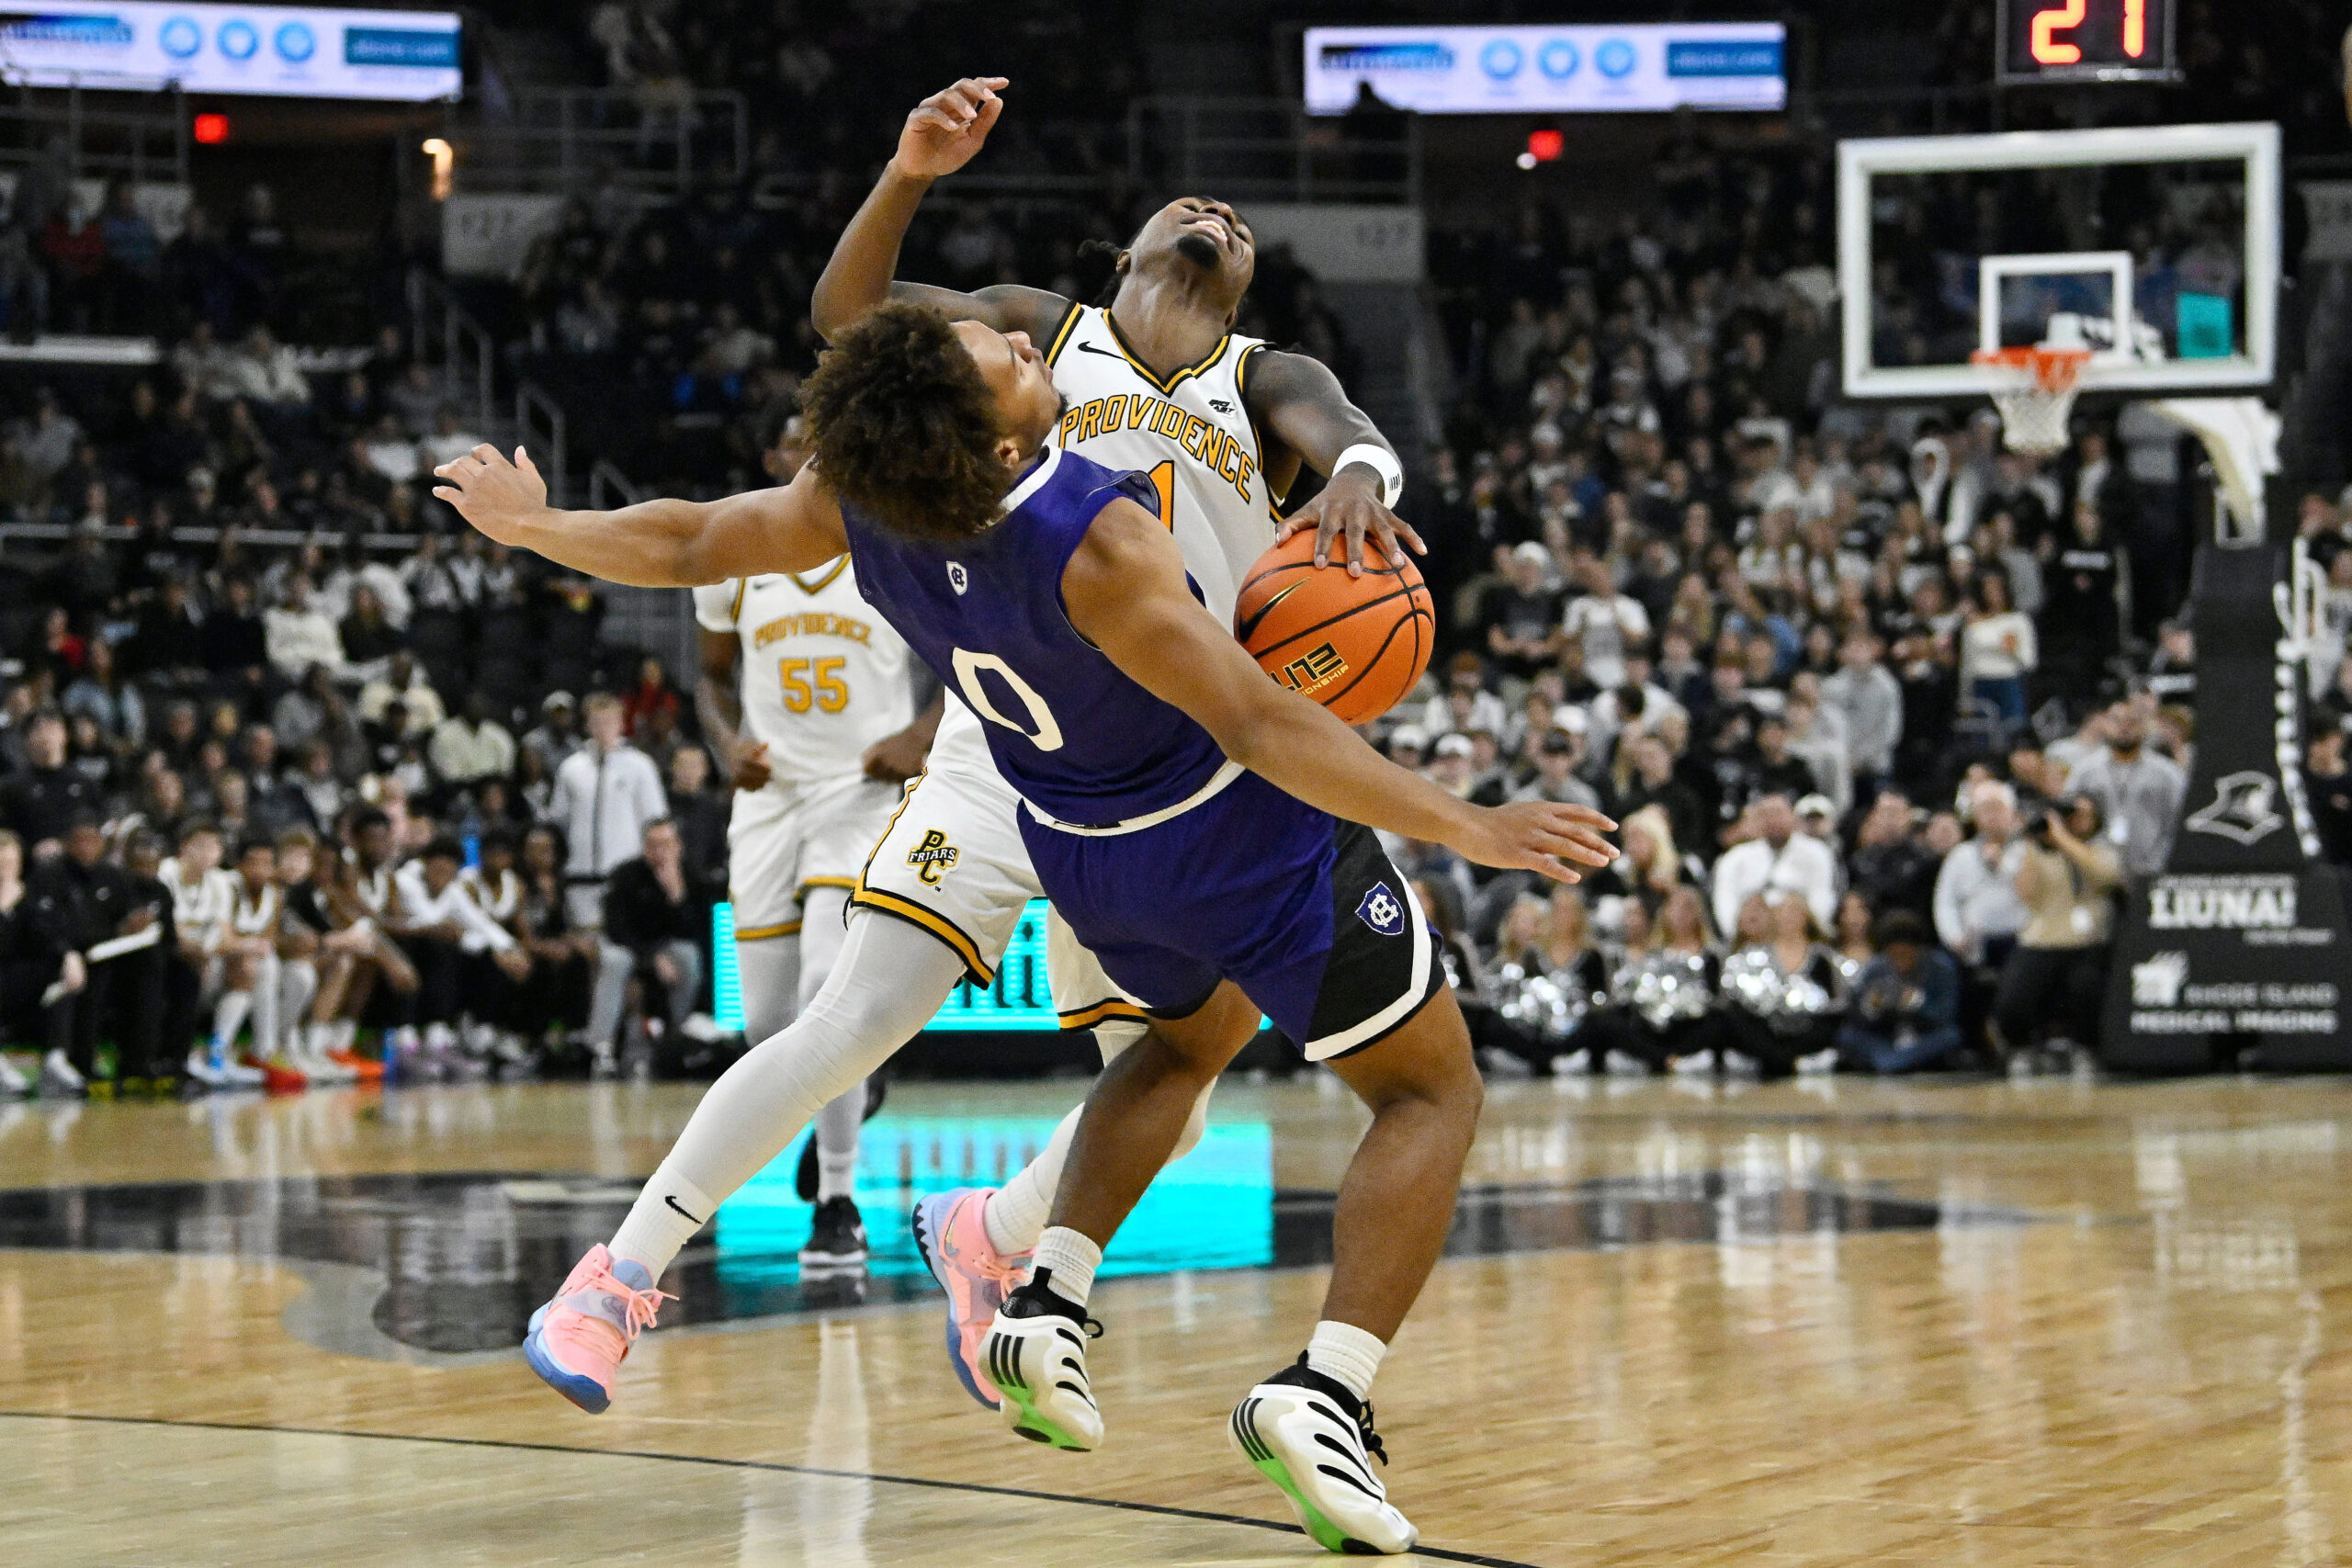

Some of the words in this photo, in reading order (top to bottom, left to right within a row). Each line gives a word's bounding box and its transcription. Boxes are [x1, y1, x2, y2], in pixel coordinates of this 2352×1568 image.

[1058, 394, 1255, 504] PROVIDENCE
[753, 611, 873, 650] PROVIDENCE
[779, 657, 849, 715] 55
[952, 647, 1064, 751] 0
[909, 848, 957, 863] FRIARS
[2148, 887, 2298, 929] LIUNA!
[2130, 1010, 2231, 1033] MEDICAL
[2233, 1010, 2338, 1033] IMAGING
